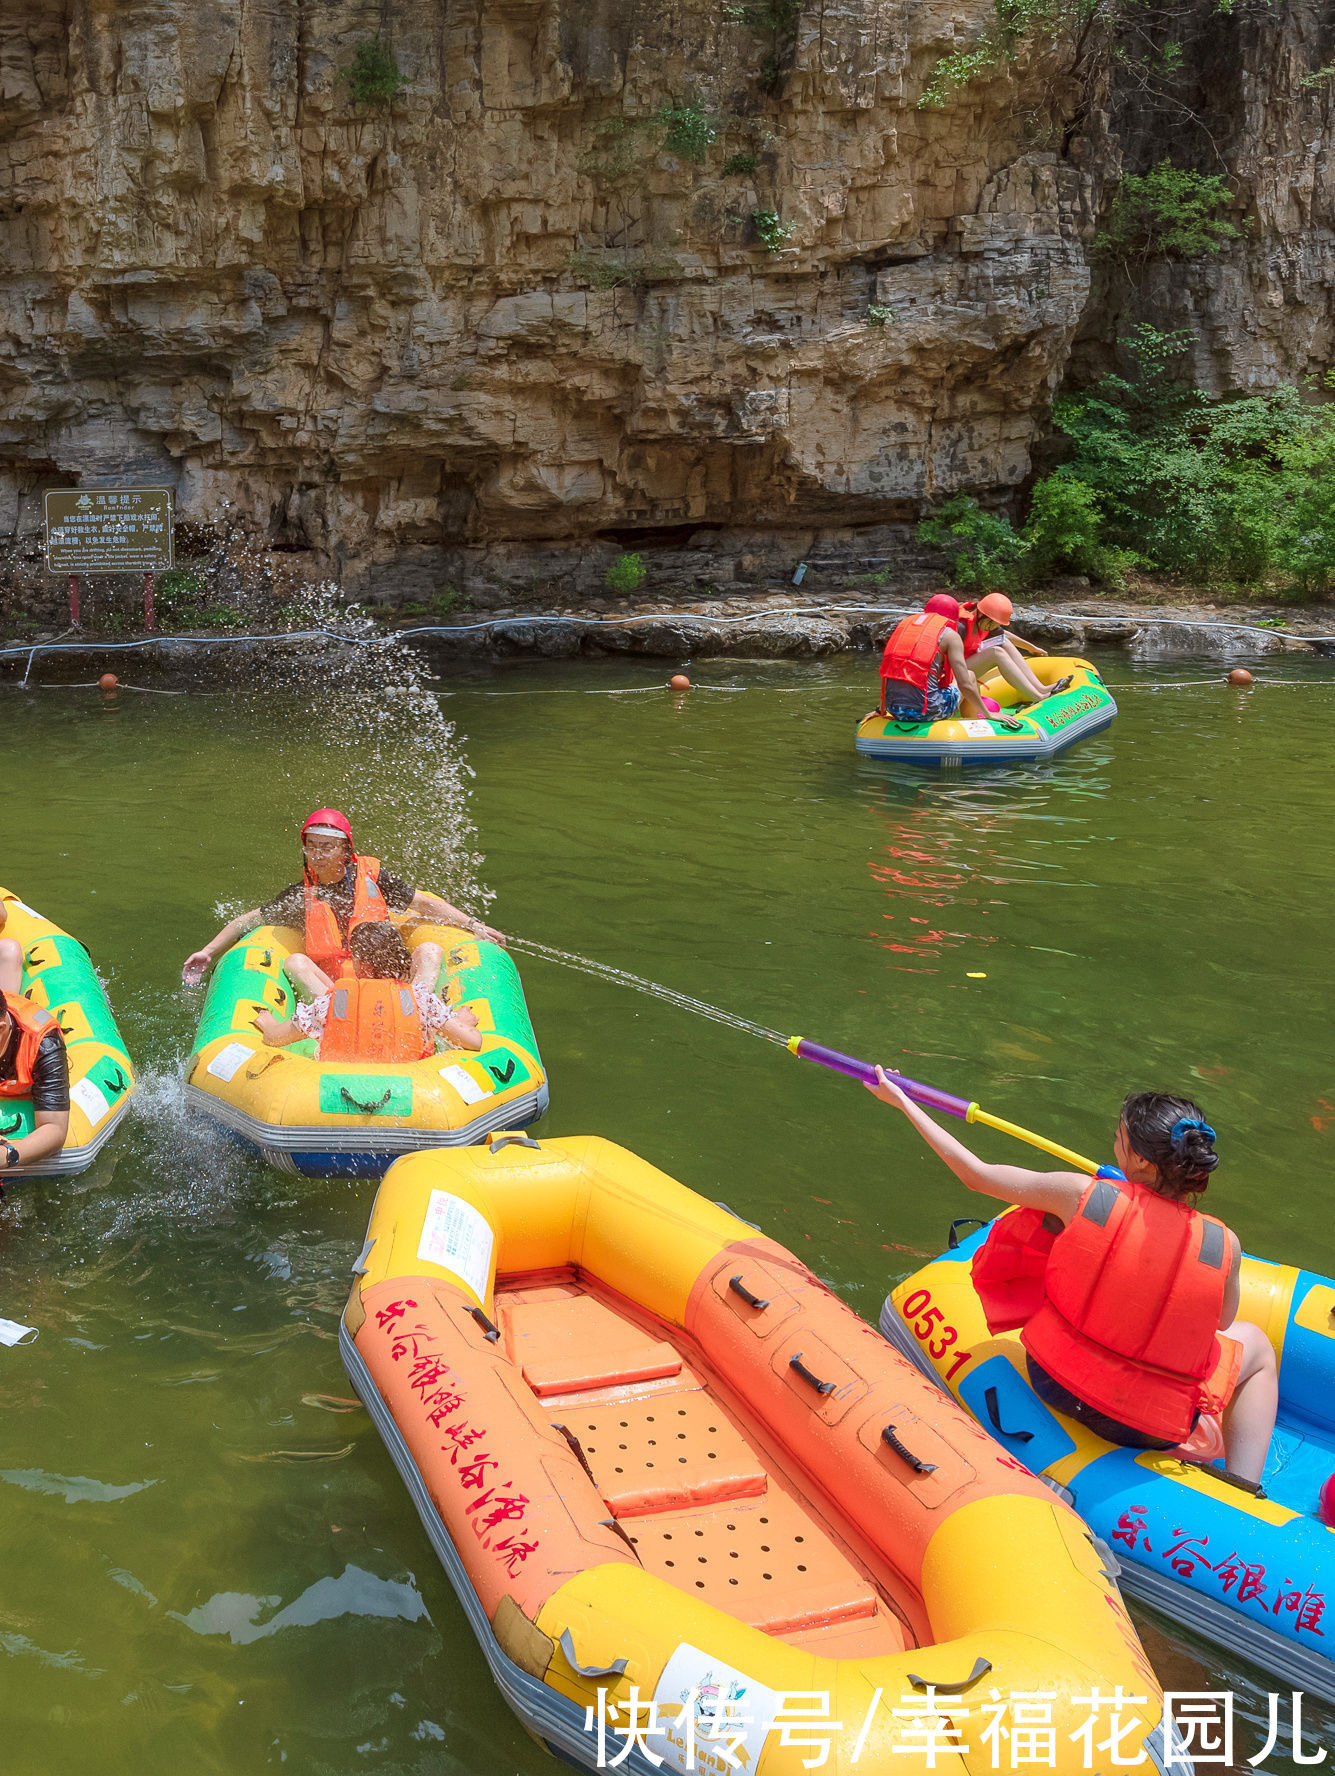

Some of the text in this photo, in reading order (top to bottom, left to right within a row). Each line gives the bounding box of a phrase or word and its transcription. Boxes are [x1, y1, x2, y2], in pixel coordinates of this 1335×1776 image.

[96, 495, 141, 504] 温馨提示
[902, 1289, 973, 1381] 0531
[375, 1299, 539, 1579] 乐谷银滩峡谷漂流
[1112, 1505, 1325, 1637] 乐谷银滩
